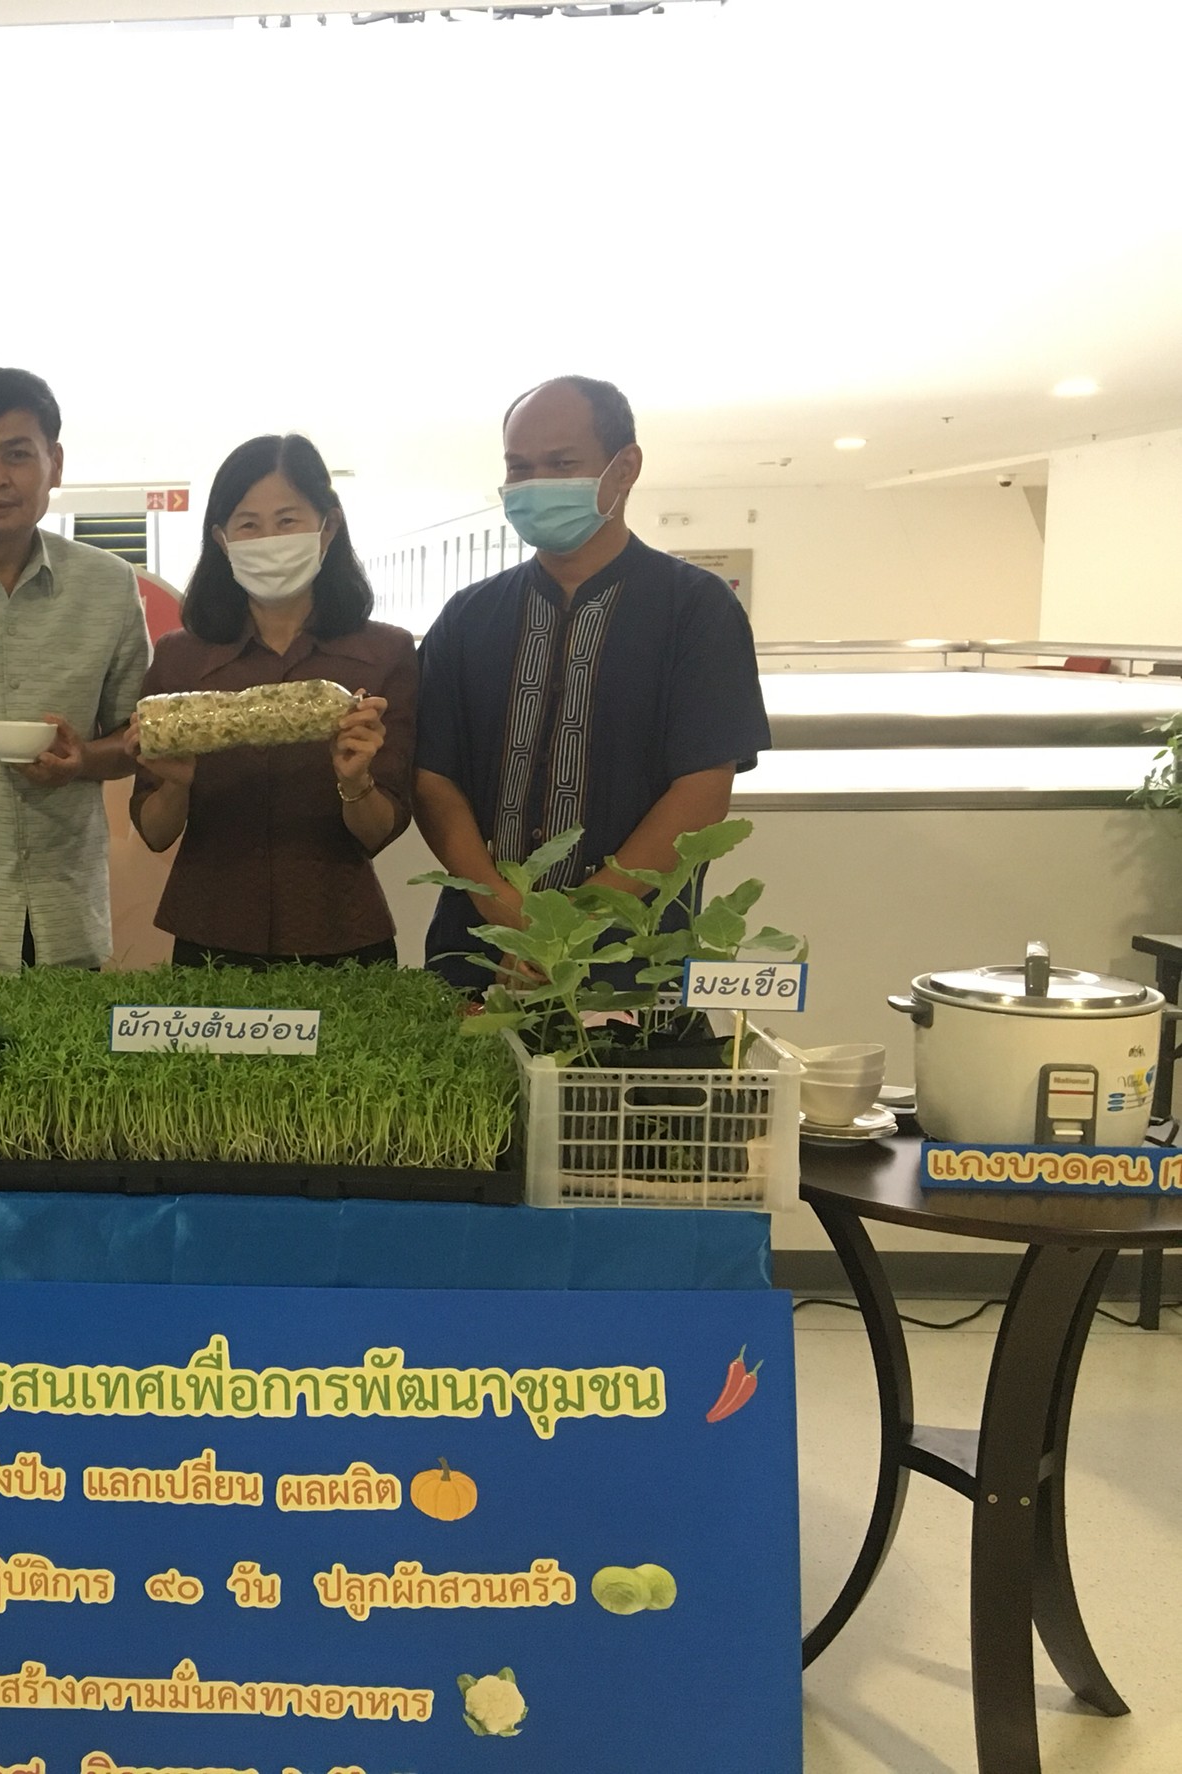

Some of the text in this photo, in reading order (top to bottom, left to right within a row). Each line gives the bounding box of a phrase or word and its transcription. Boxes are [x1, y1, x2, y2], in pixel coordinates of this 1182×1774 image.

[693, 966, 798, 998] มะเขือ
[117, 1010, 317, 1048] ผักบุ้งต้นอ่อน
[932, 1154, 1148, 1183] แกงบวดคน
[87, 1453, 260, 1502] แลกเปลี่ยน
[281, 1467, 397, 1507] ผลผลิต
[149, 1573, 200, 1600] ๙๐
[231, 1565, 278, 1603] วัน
[317, 1562, 573, 1617] ปลูกผักสวนครัว
